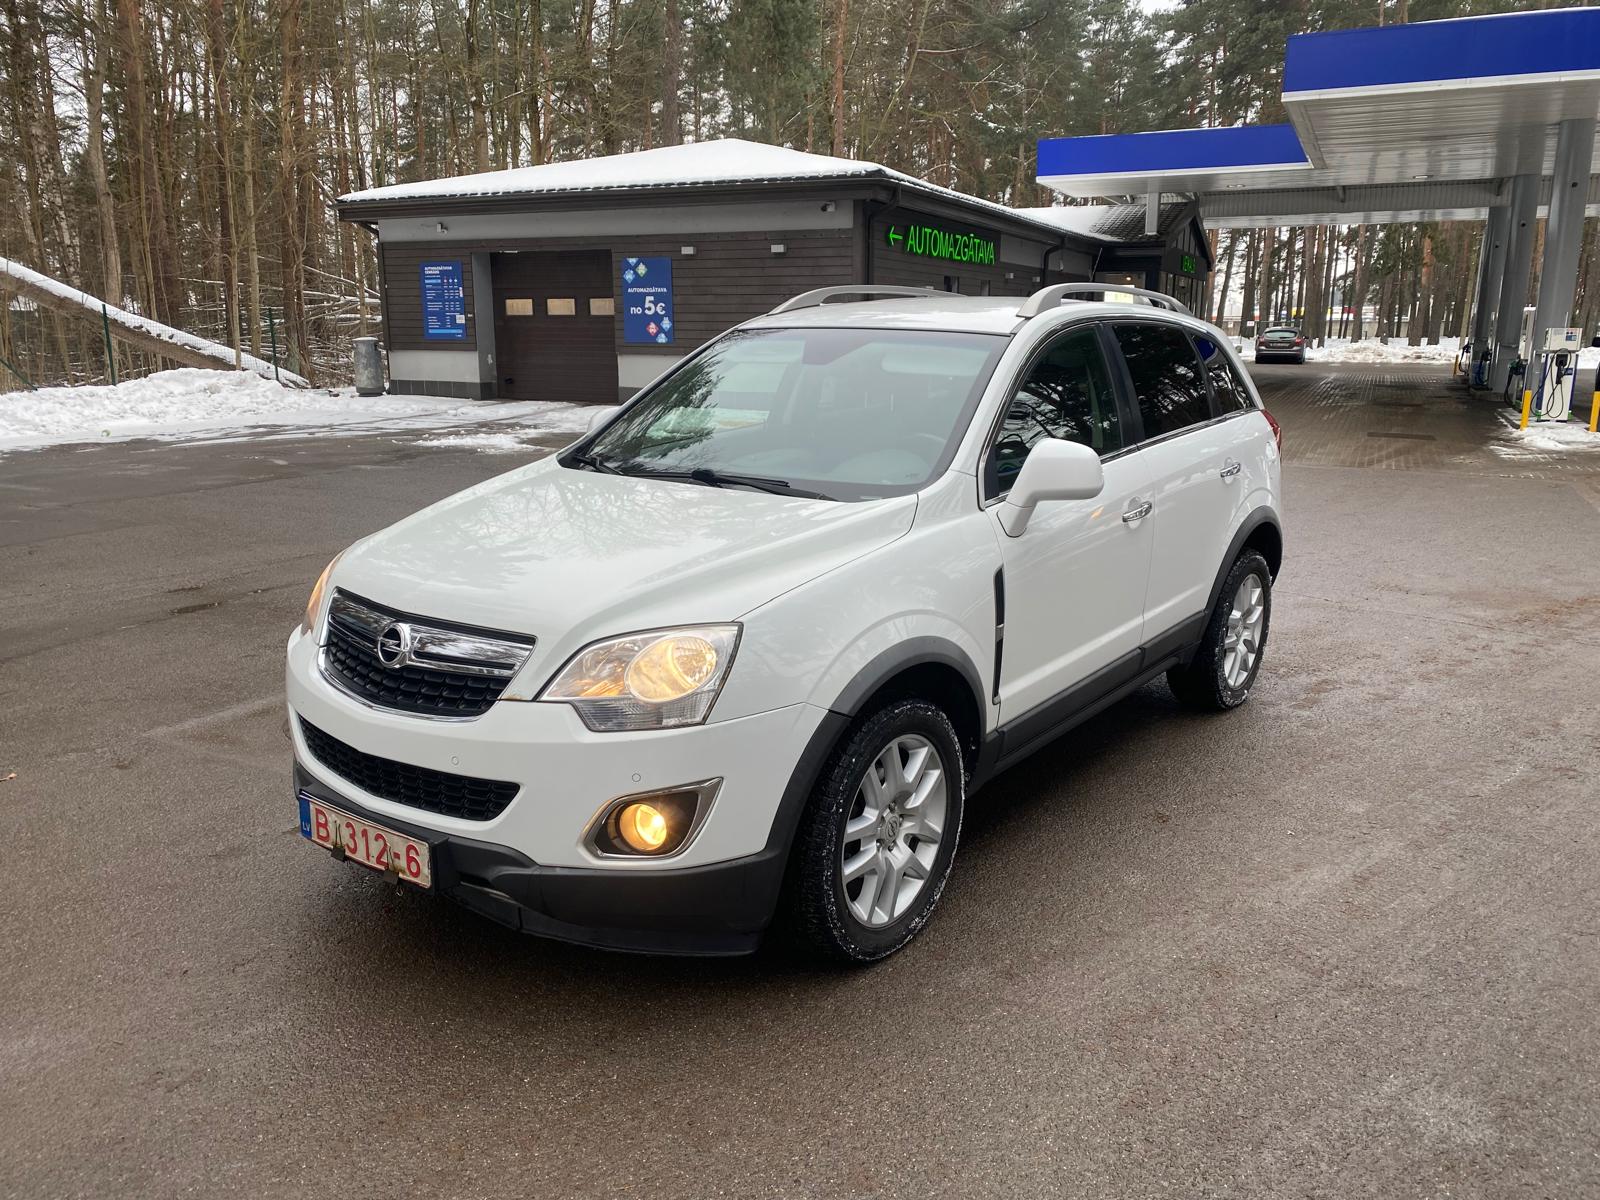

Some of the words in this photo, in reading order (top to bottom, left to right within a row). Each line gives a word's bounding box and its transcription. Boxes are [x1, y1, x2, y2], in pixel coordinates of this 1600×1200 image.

[907, 225, 995, 265] AUTOMAZGĀTAVA
[630, 306, 642, 315] no
[644, 296, 666, 315] 5€
[302, 821, 311, 832] LV
